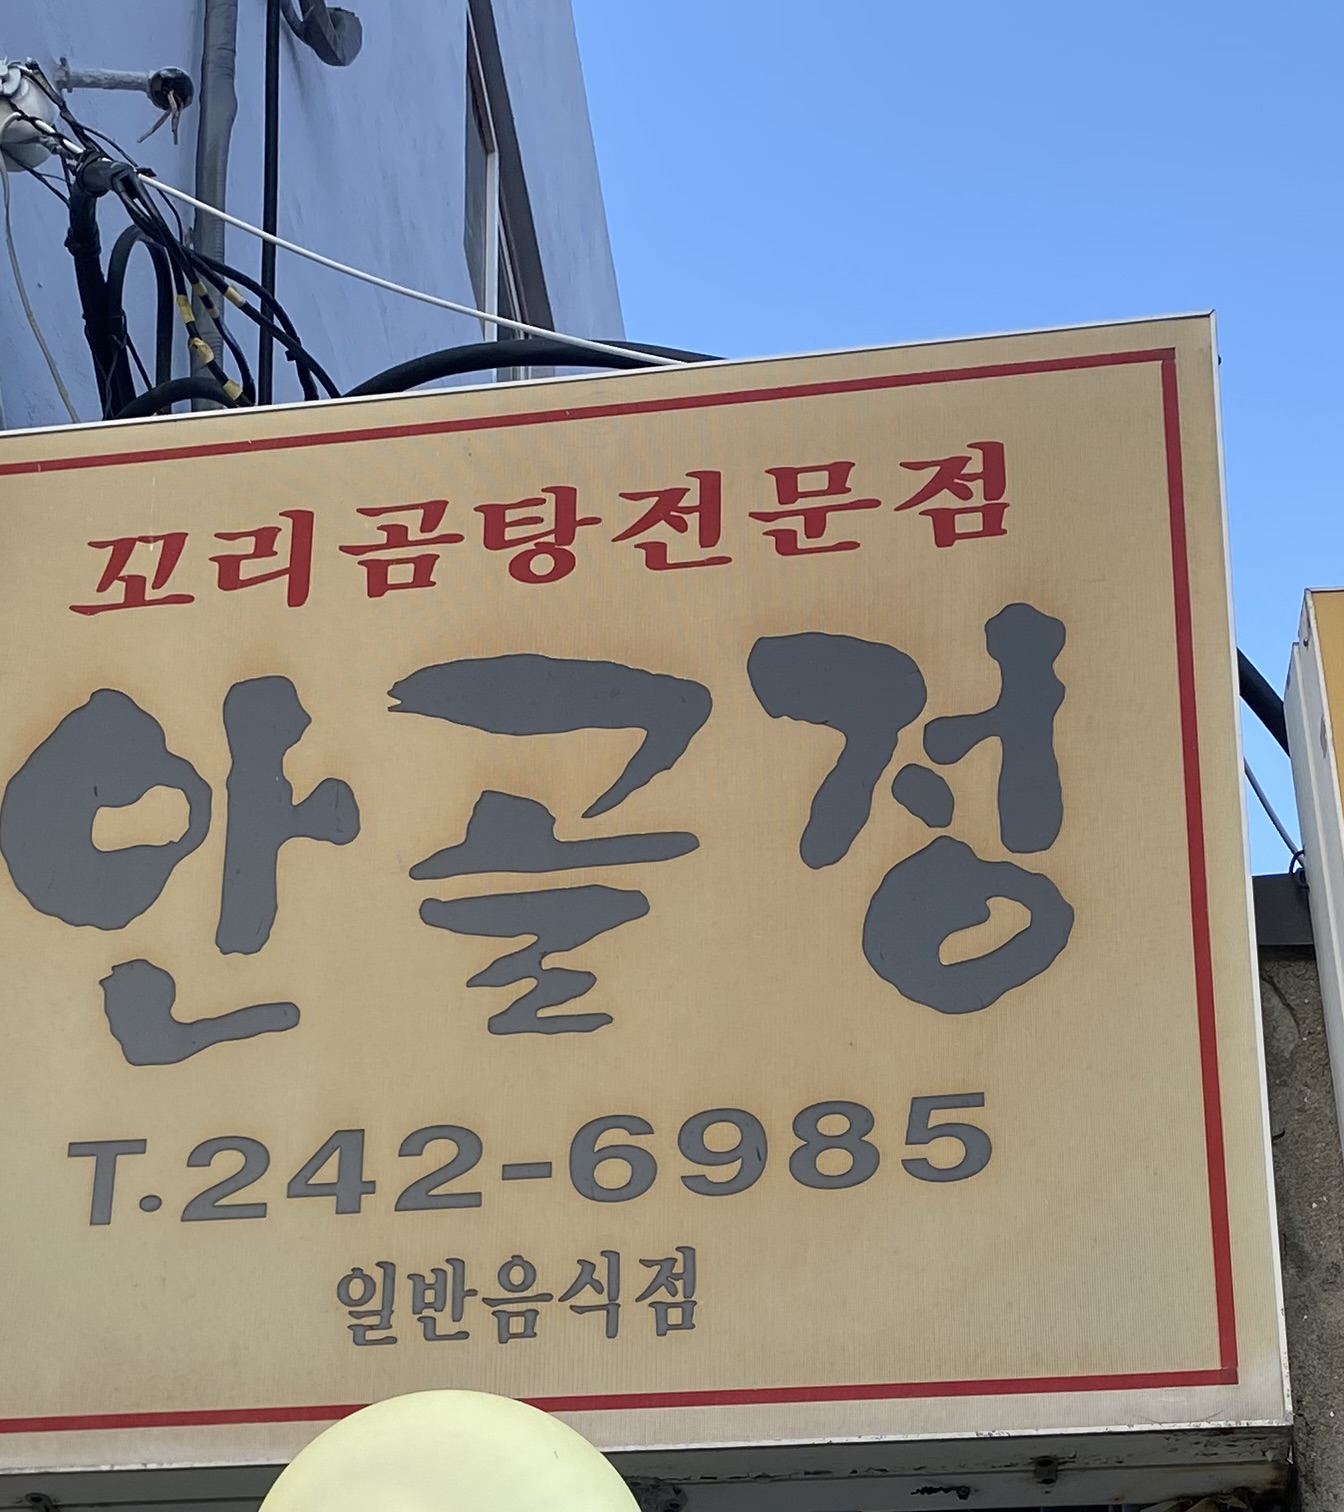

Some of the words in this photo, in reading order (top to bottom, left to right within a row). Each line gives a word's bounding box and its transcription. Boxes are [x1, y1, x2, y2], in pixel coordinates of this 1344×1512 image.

[68, 439, 1015, 617] 꼬리곰탕전문점
[67, 1093, 994, 1227] T.242-6985
[337, 1245, 701, 1346] 일반음식점
